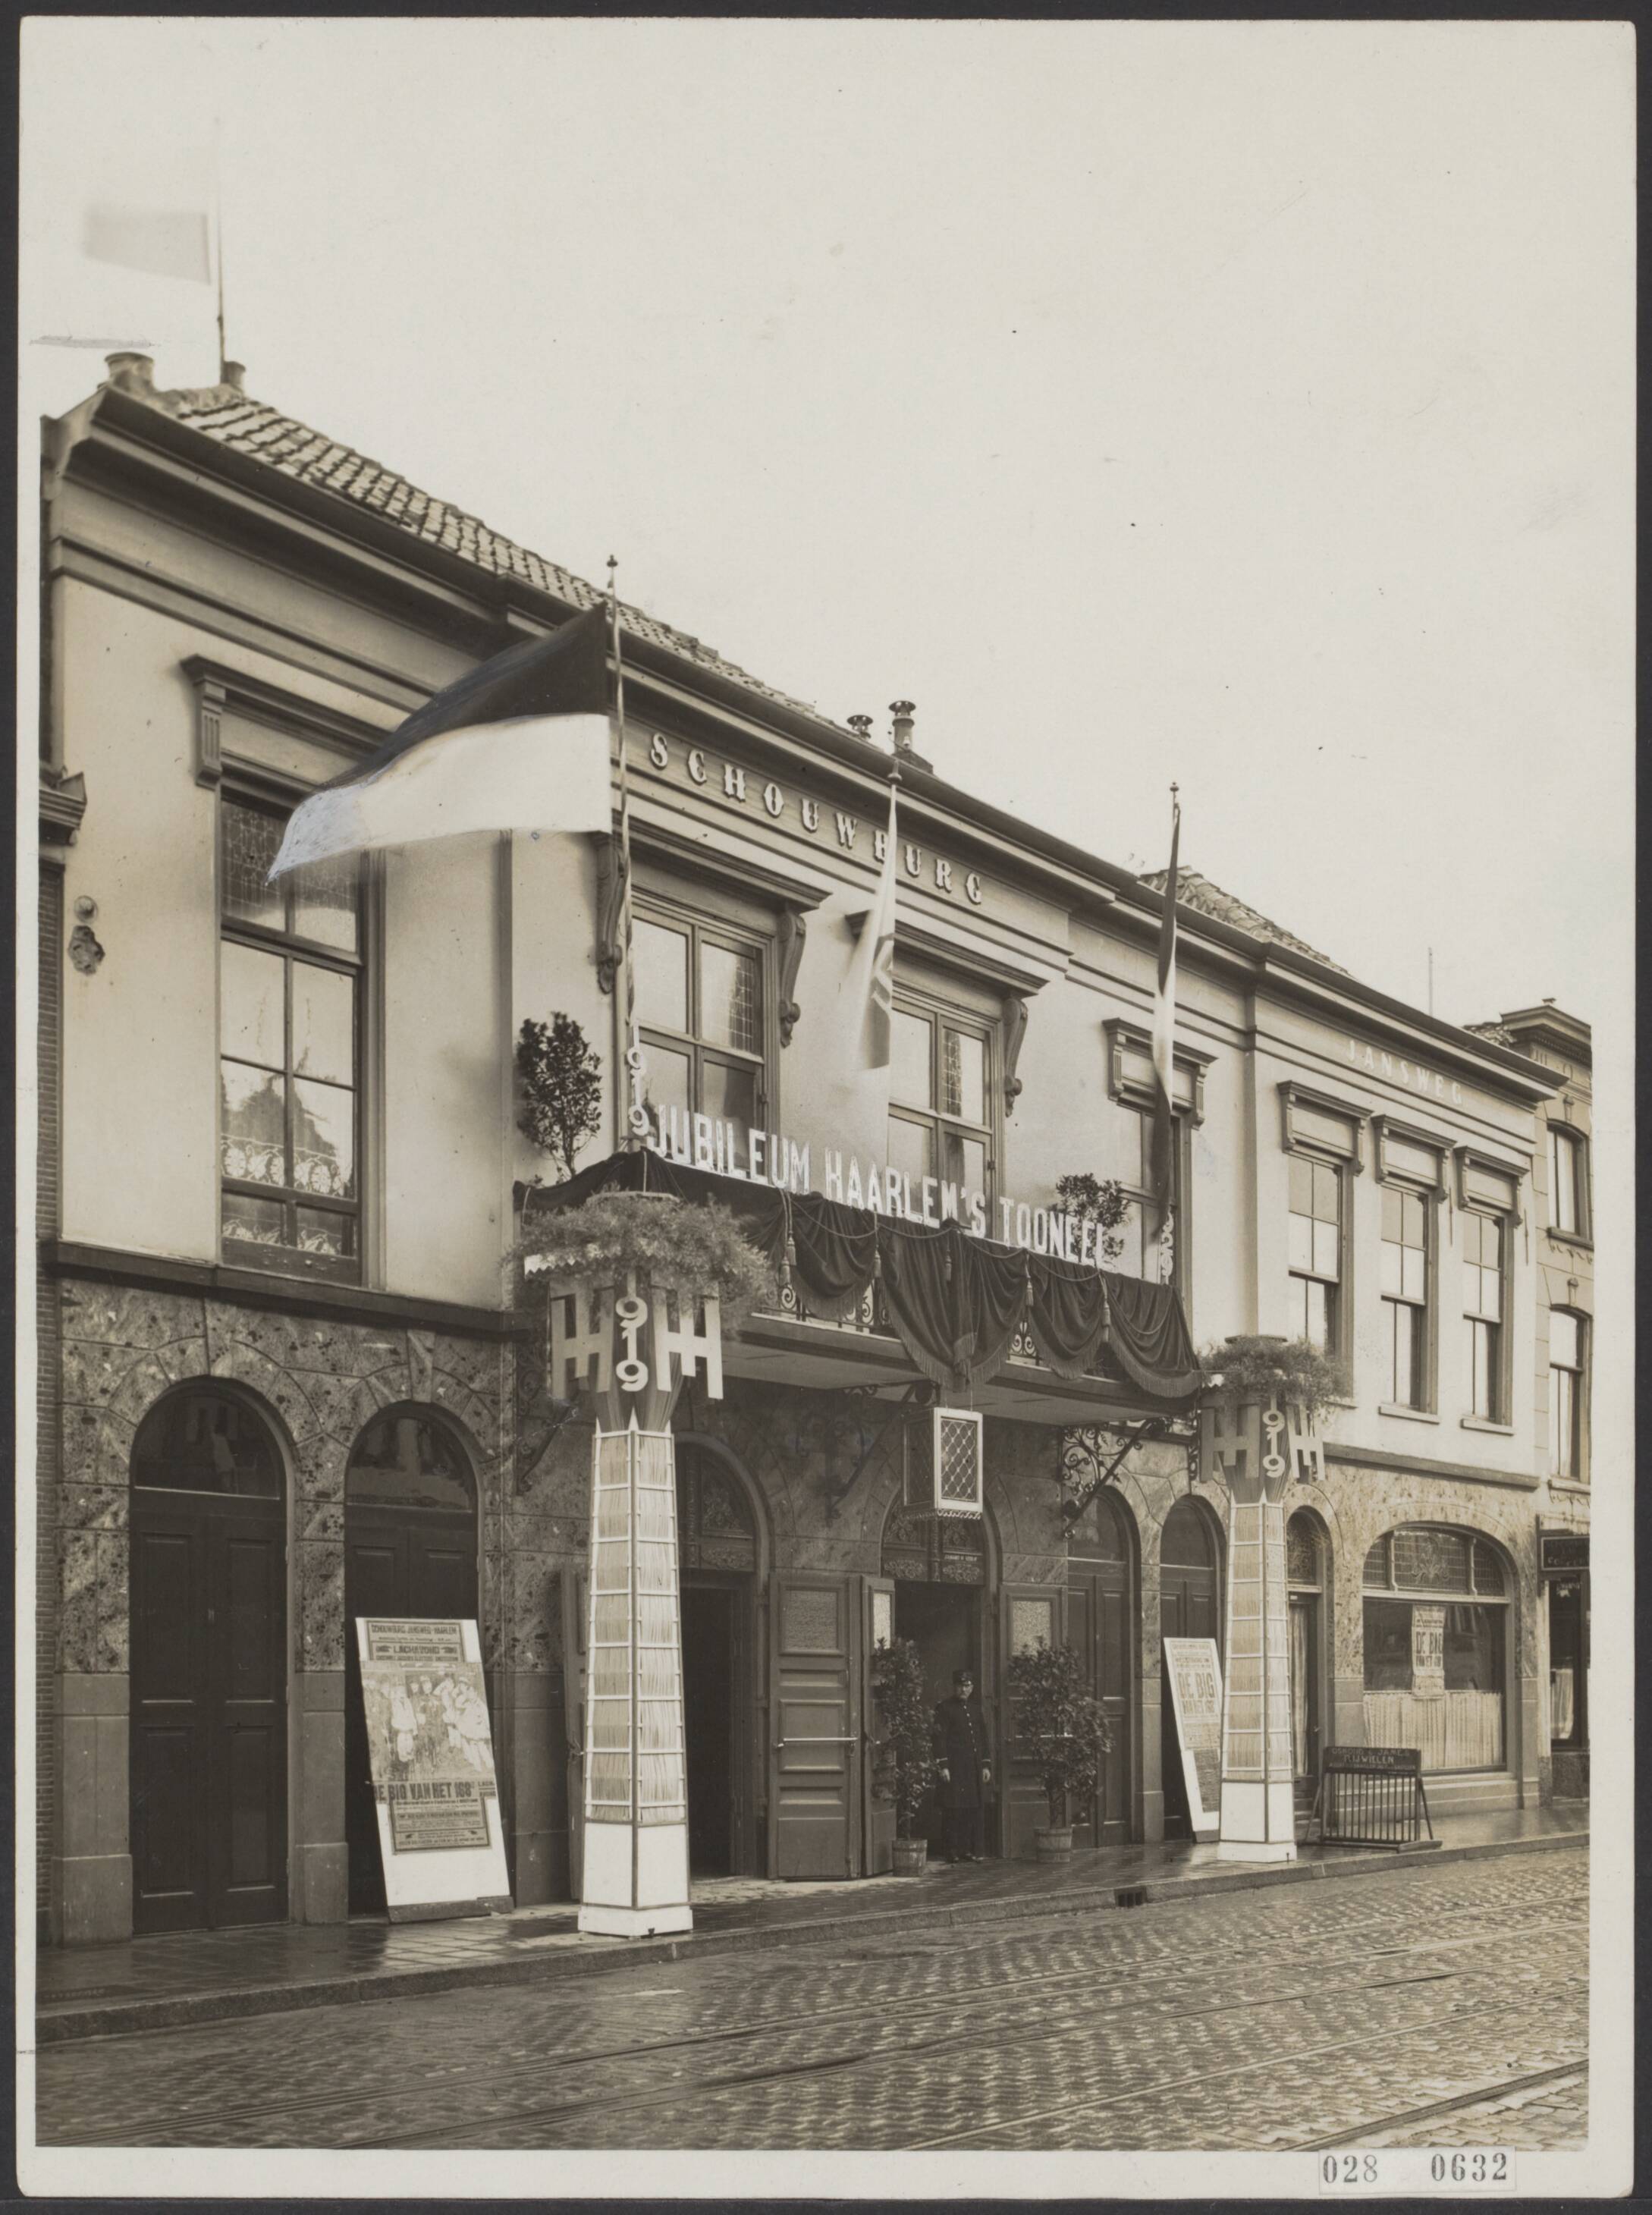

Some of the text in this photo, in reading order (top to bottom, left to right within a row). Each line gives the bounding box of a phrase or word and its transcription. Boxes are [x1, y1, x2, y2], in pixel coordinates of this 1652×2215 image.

[650, 733, 982, 905] SCHOUWBURG
[1346, 1040, 1462, 1105] JANSWEG
[646, 1104, 811, 1195] JUBILEUM
[824, 1147, 987, 1238] HAARLEM'S
[1176, 1672, 1215, 1698] DE BIG
